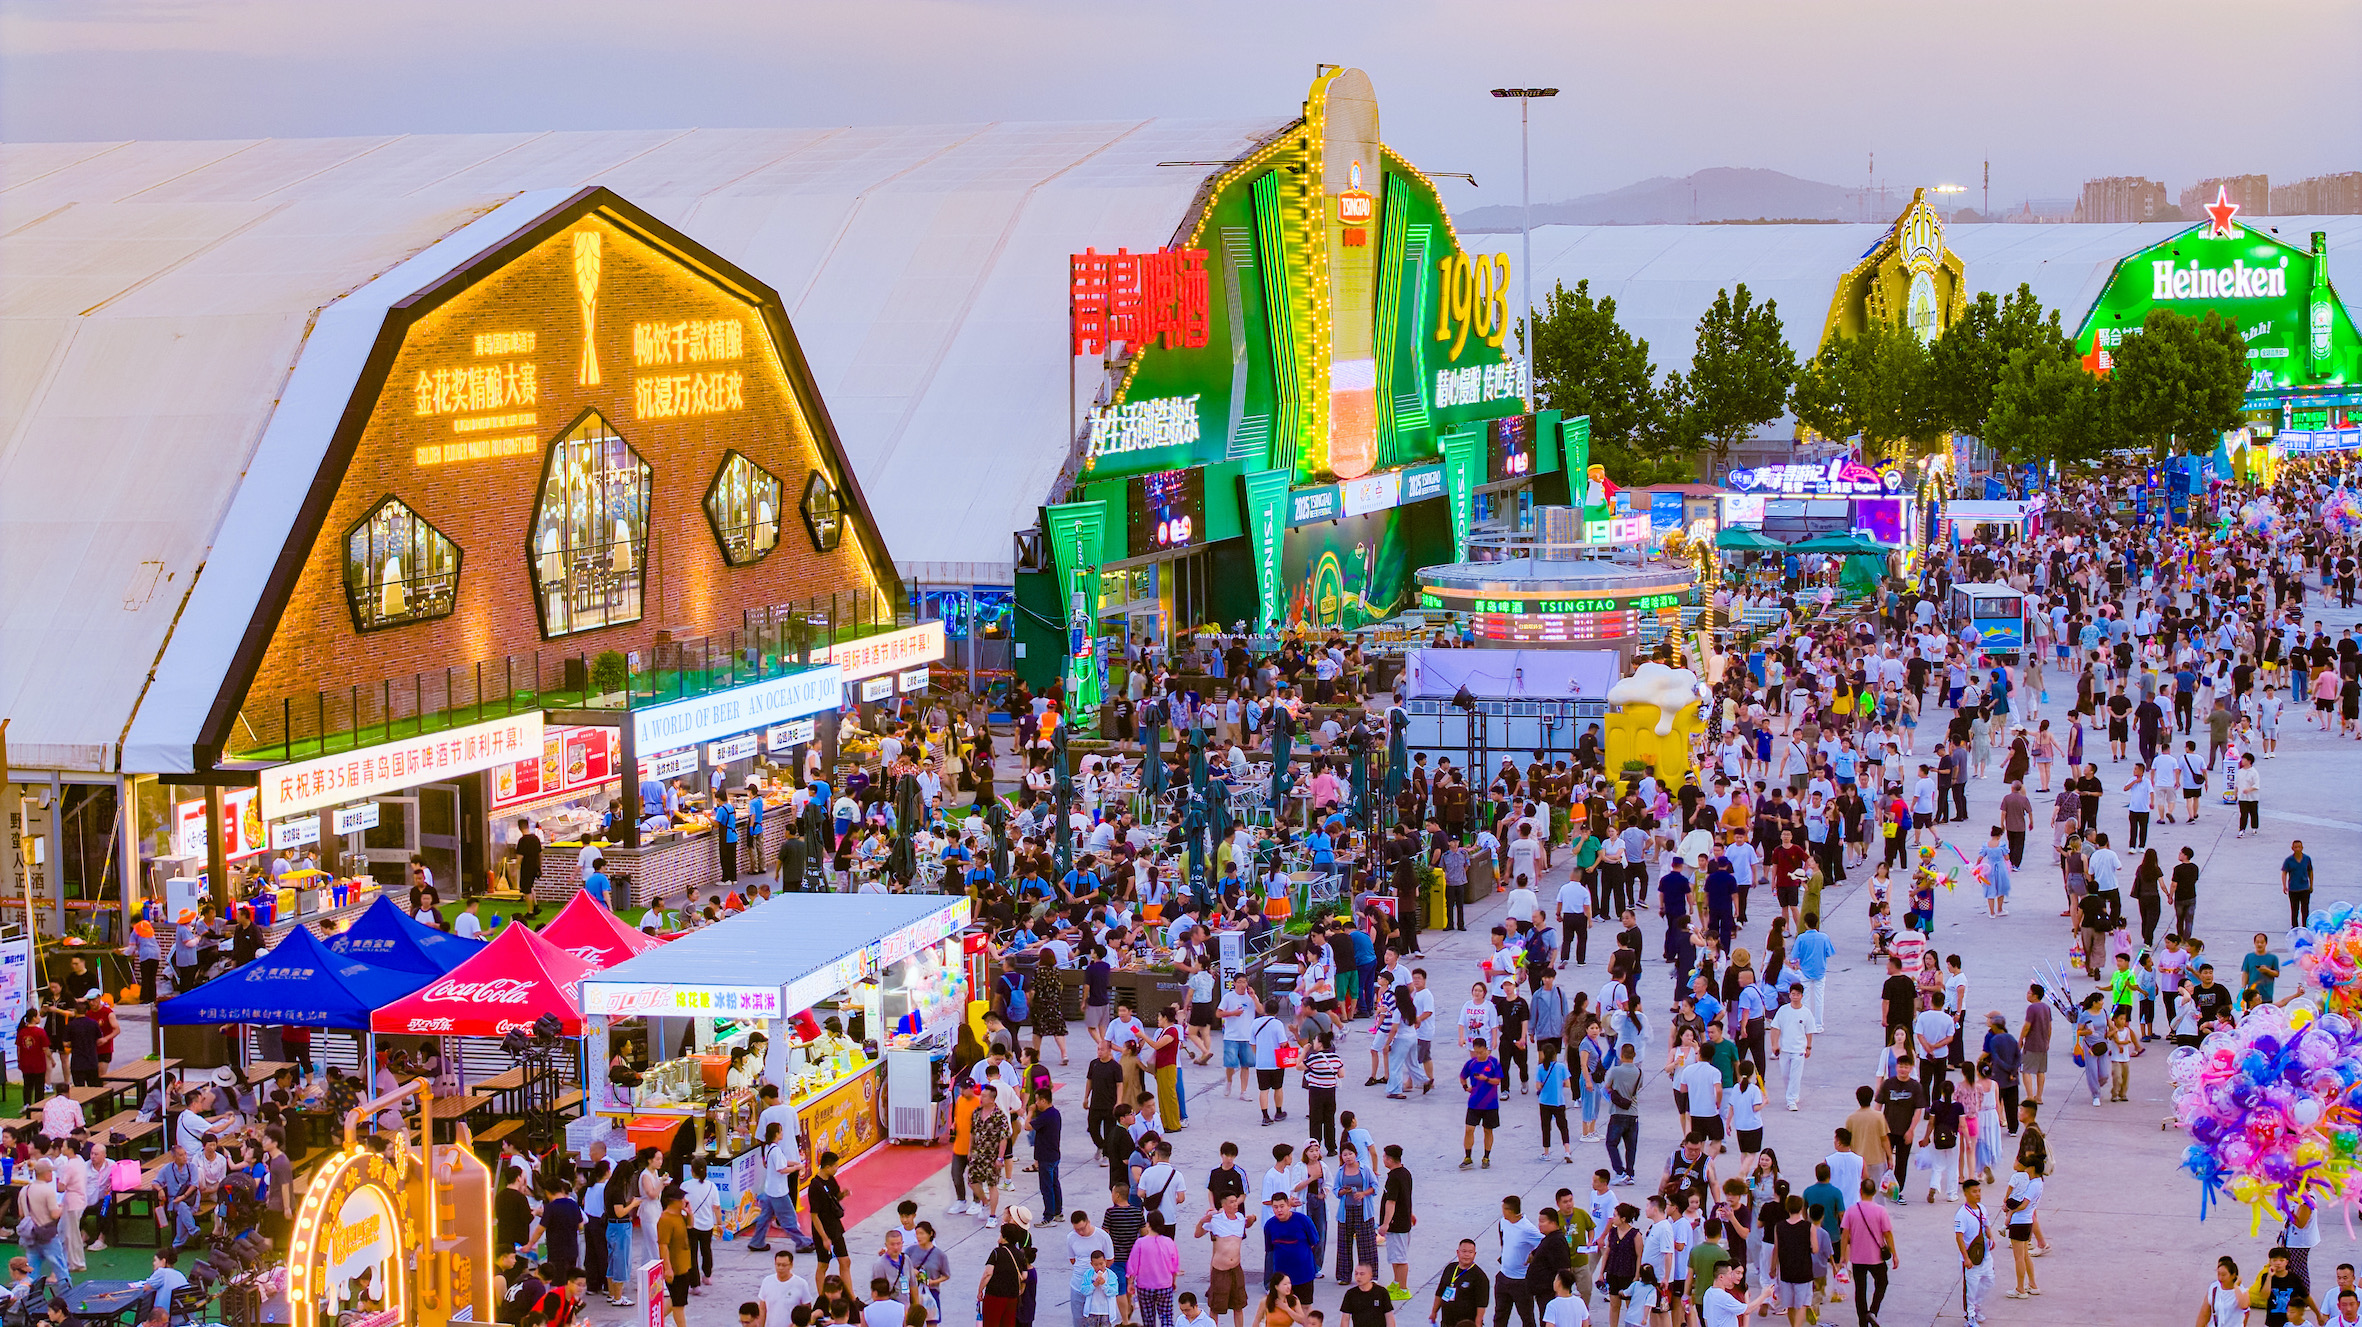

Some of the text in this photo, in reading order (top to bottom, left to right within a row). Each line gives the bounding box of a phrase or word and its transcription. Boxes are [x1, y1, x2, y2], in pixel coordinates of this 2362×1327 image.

[1341, 198, 1370, 217] TSINGTAO
[2151, 259, 2287, 300] Heineken
[1071, 247, 1209, 356] 青岛啤酒
[1435, 252, 1511, 362] 1903
[474, 332, 537, 356] 青岛国际啤酒节
[634, 319, 743, 367] 畅饮千款精酿
[415, 363, 537, 415] 金花奖精酿大赛
[635, 370, 743, 419] 沉浸万众狂欢
[1435, 361, 1527, 408] 精心慢酿 传世麦香
[416, 445, 442, 466] GOLDEN
[443, 443, 469, 463] FLOWER
[468, 441, 490, 460] AWARD
[491, 439, 502, 457] FOR
[502, 437, 521, 456] CRAFT
[1408, 473, 1422, 498] 2025
[1853, 481, 1882, 492] Yogurt
[1294, 496, 1310, 521] 2025
[1457, 463, 1466, 563] TSINGTA
[1263, 502, 1274, 629] TSINGTA
[1475, 600, 1524, 613] 青岛啤酒
[1539, 599, 1616, 613] TSINGTAO
[641, 676, 836, 742] A WORLD OF BEER AN OCEAN OF JOY
[423, 978, 539, 1004] Coca-Cola
[606, 984, 674, 1014] 可口可乐
[714, 992, 737, 1010] 冰粉
[740, 992, 775, 1011] 冰淇淋
[198, 1009, 328, 1022] 中国高端精酿白啤领先品牌
[406, 1016, 456, 1032] 可口可乐
